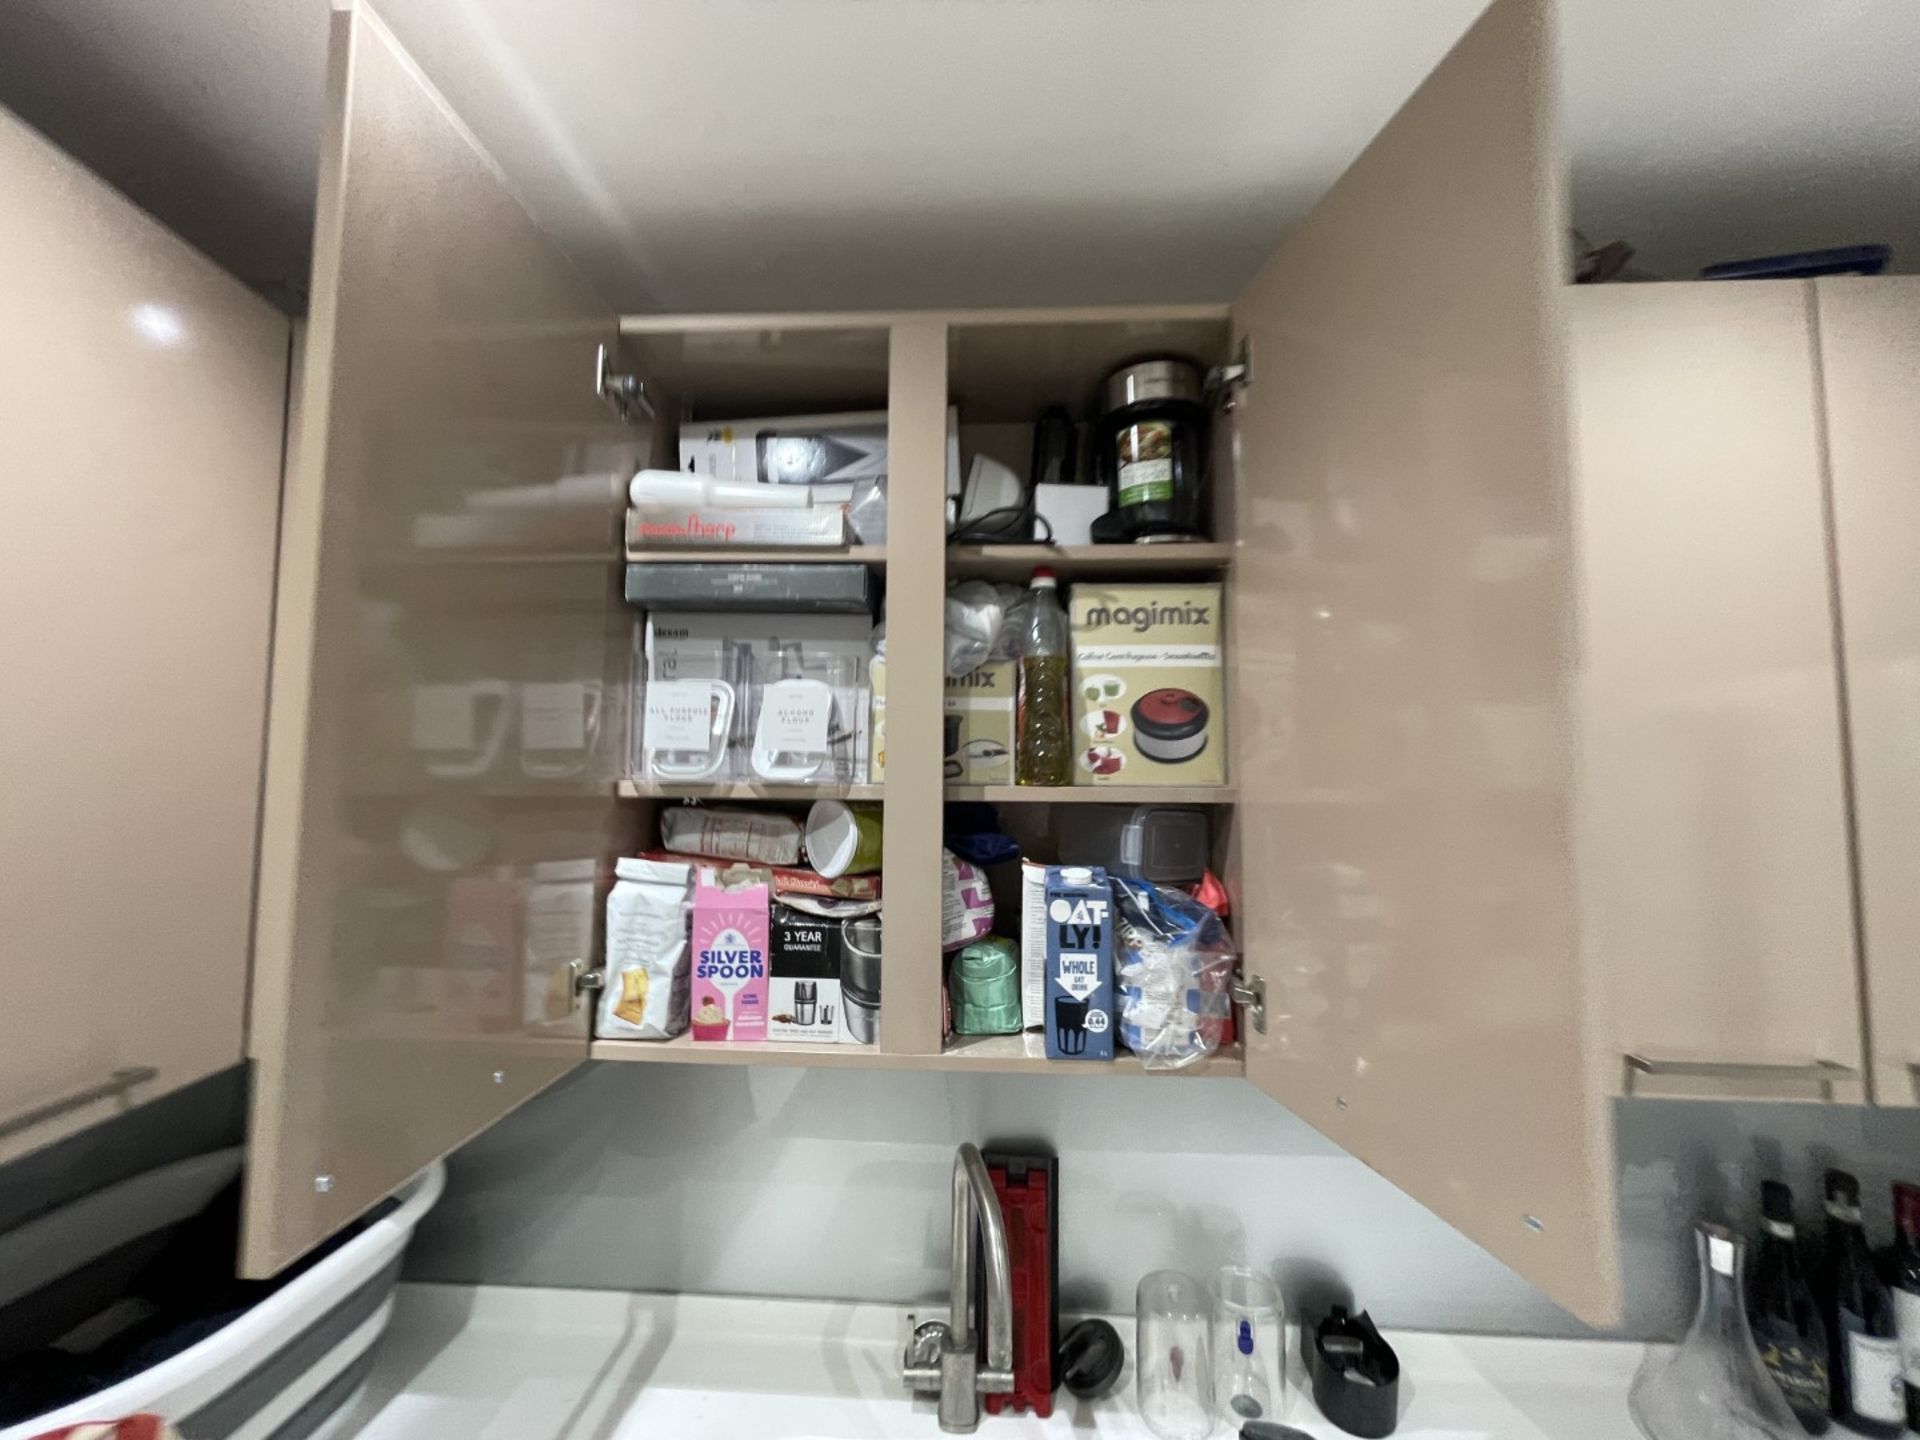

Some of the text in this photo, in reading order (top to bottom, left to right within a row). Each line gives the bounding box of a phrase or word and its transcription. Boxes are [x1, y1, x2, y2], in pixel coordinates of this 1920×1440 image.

[1086, 601, 1210, 632] magimix
[778, 708, 815, 717] ALMOND
[784, 931, 822, 942] 3 YEAR
[1060, 924, 1101, 949] LY!
[700, 950, 762, 964] SILVER
[697, 964, 764, 979] SPOON
[1062, 960, 1095, 975] WHOLE
